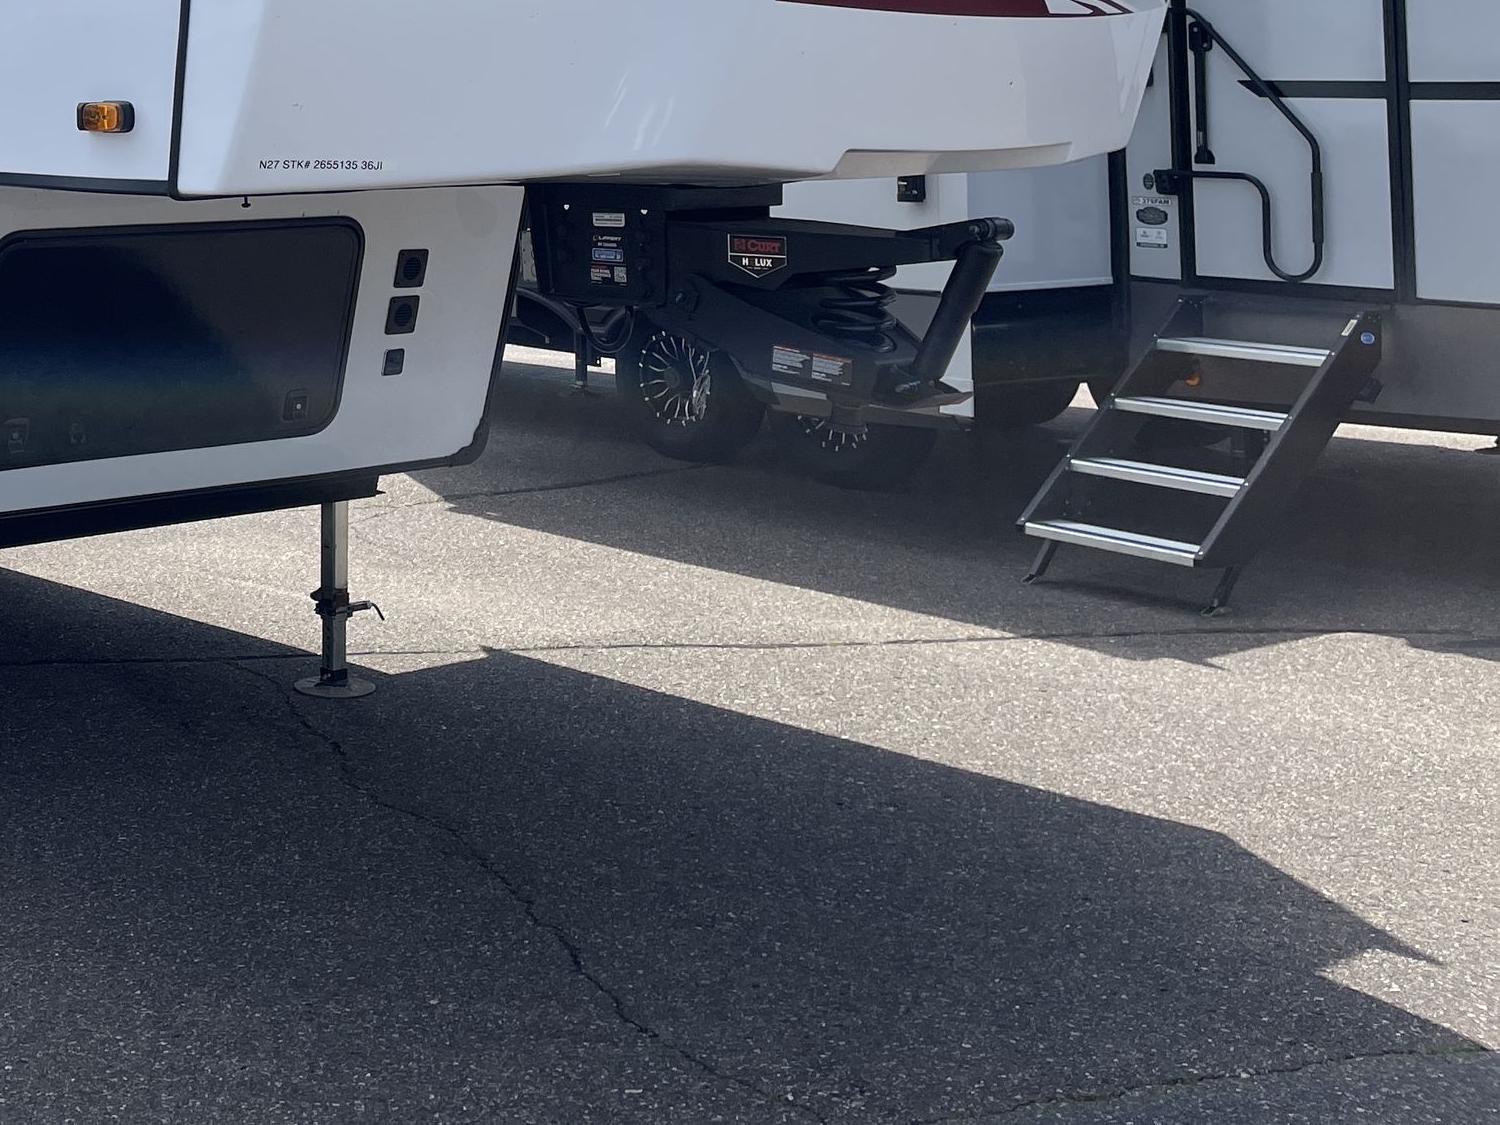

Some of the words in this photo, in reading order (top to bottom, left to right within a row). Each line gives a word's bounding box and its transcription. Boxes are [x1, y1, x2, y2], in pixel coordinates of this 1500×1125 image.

[259, 159, 280, 170] N27
[282, 159, 311, 170] STK#
[313, 159, 358, 170] 2655135
[360, 160, 383, 171] 36JI
